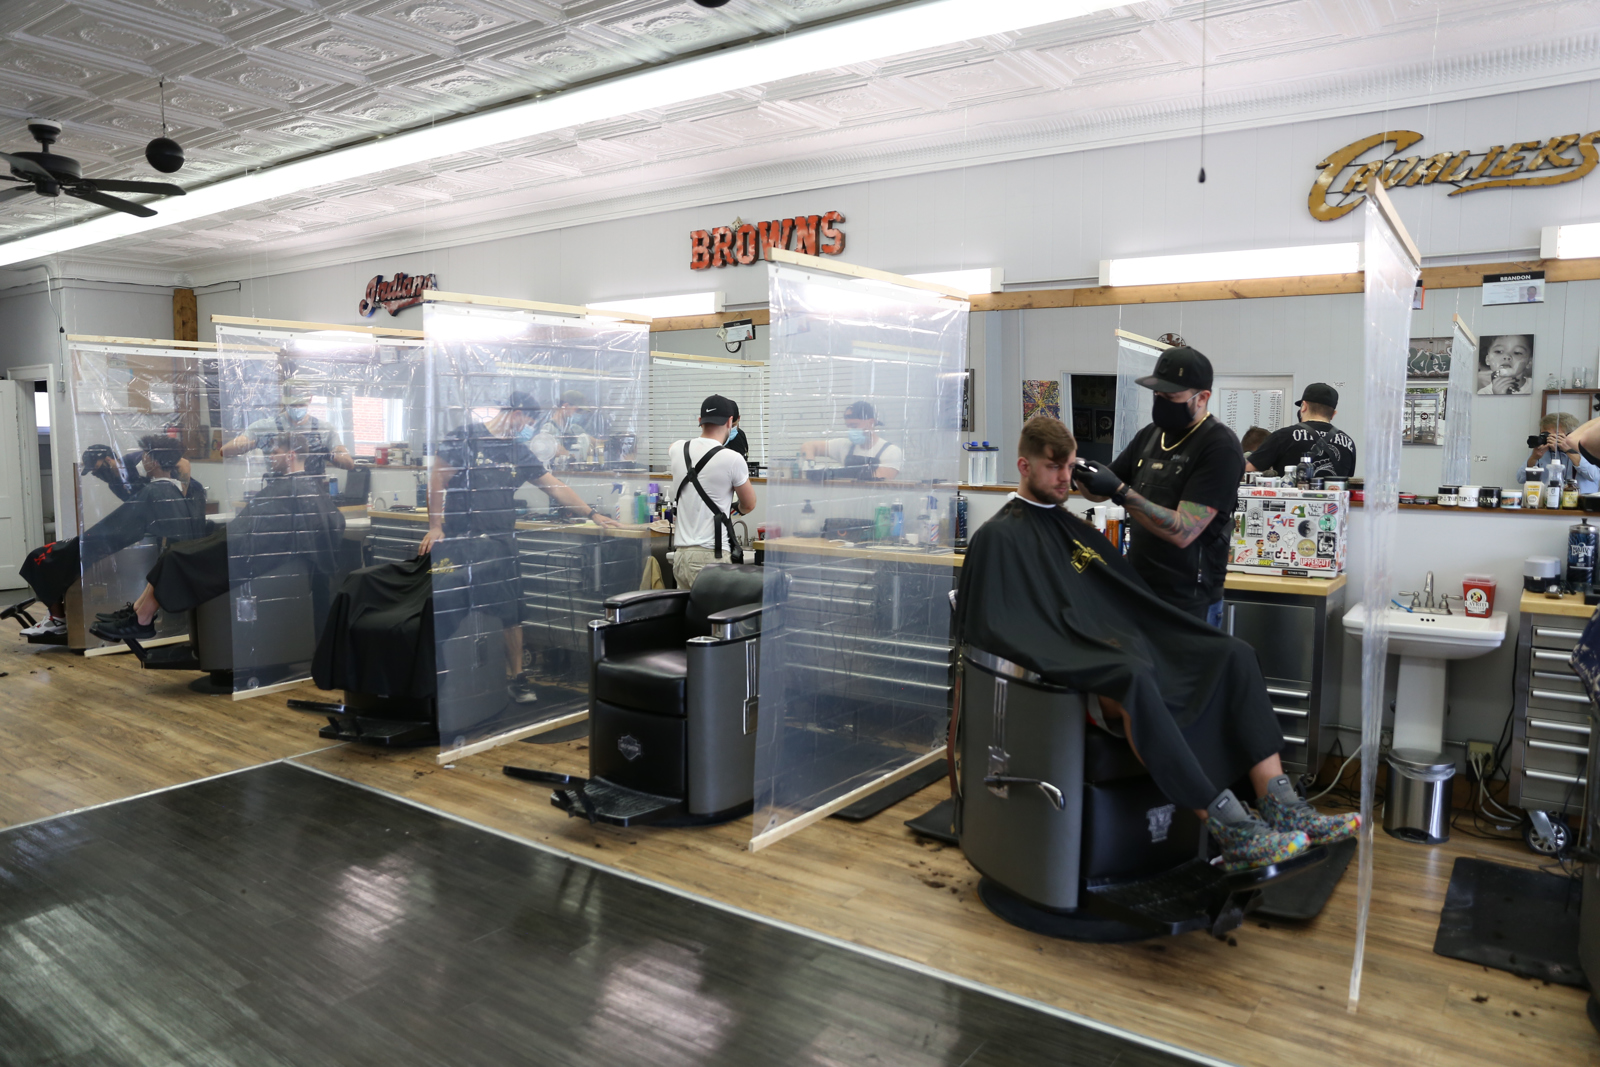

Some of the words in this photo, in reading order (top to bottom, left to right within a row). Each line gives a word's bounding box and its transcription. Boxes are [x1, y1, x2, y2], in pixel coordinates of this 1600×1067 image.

[690, 210, 846, 270] BROWNS
[1500, 274, 1531, 282] BRANDON
[1267, 518, 1295, 528] LVE
[1245, 558, 1274, 566] SUBWAY
[1300, 558, 1330, 568] UPPERCUT
